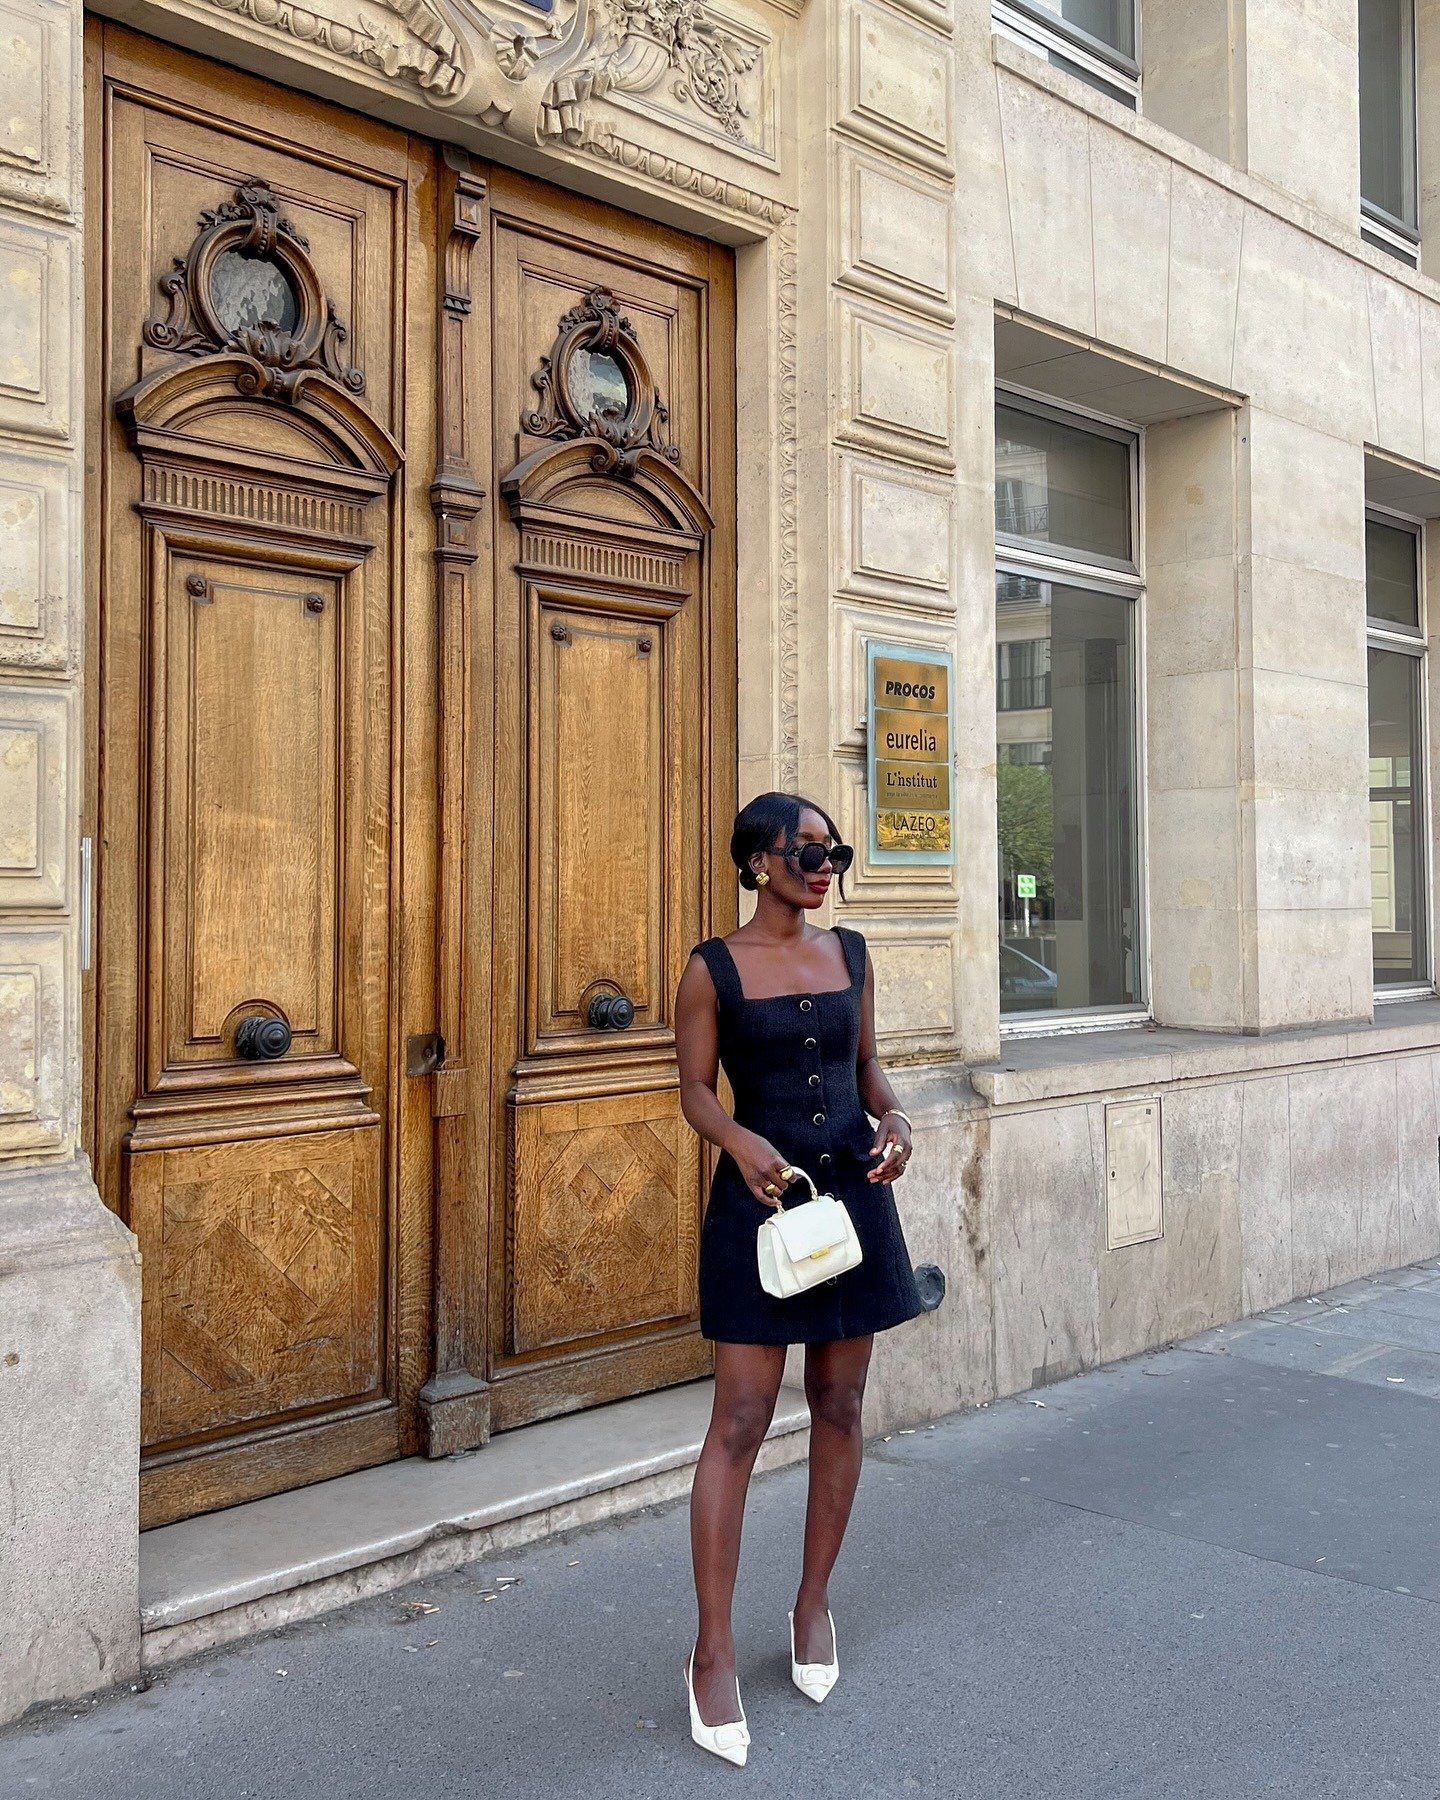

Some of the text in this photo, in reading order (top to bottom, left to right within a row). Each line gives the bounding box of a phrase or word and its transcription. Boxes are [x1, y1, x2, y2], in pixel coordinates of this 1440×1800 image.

[886, 681, 935, 699] PROCOS
[886, 729, 936, 751] eurelia
[893, 815, 935, 831] LAZEO
